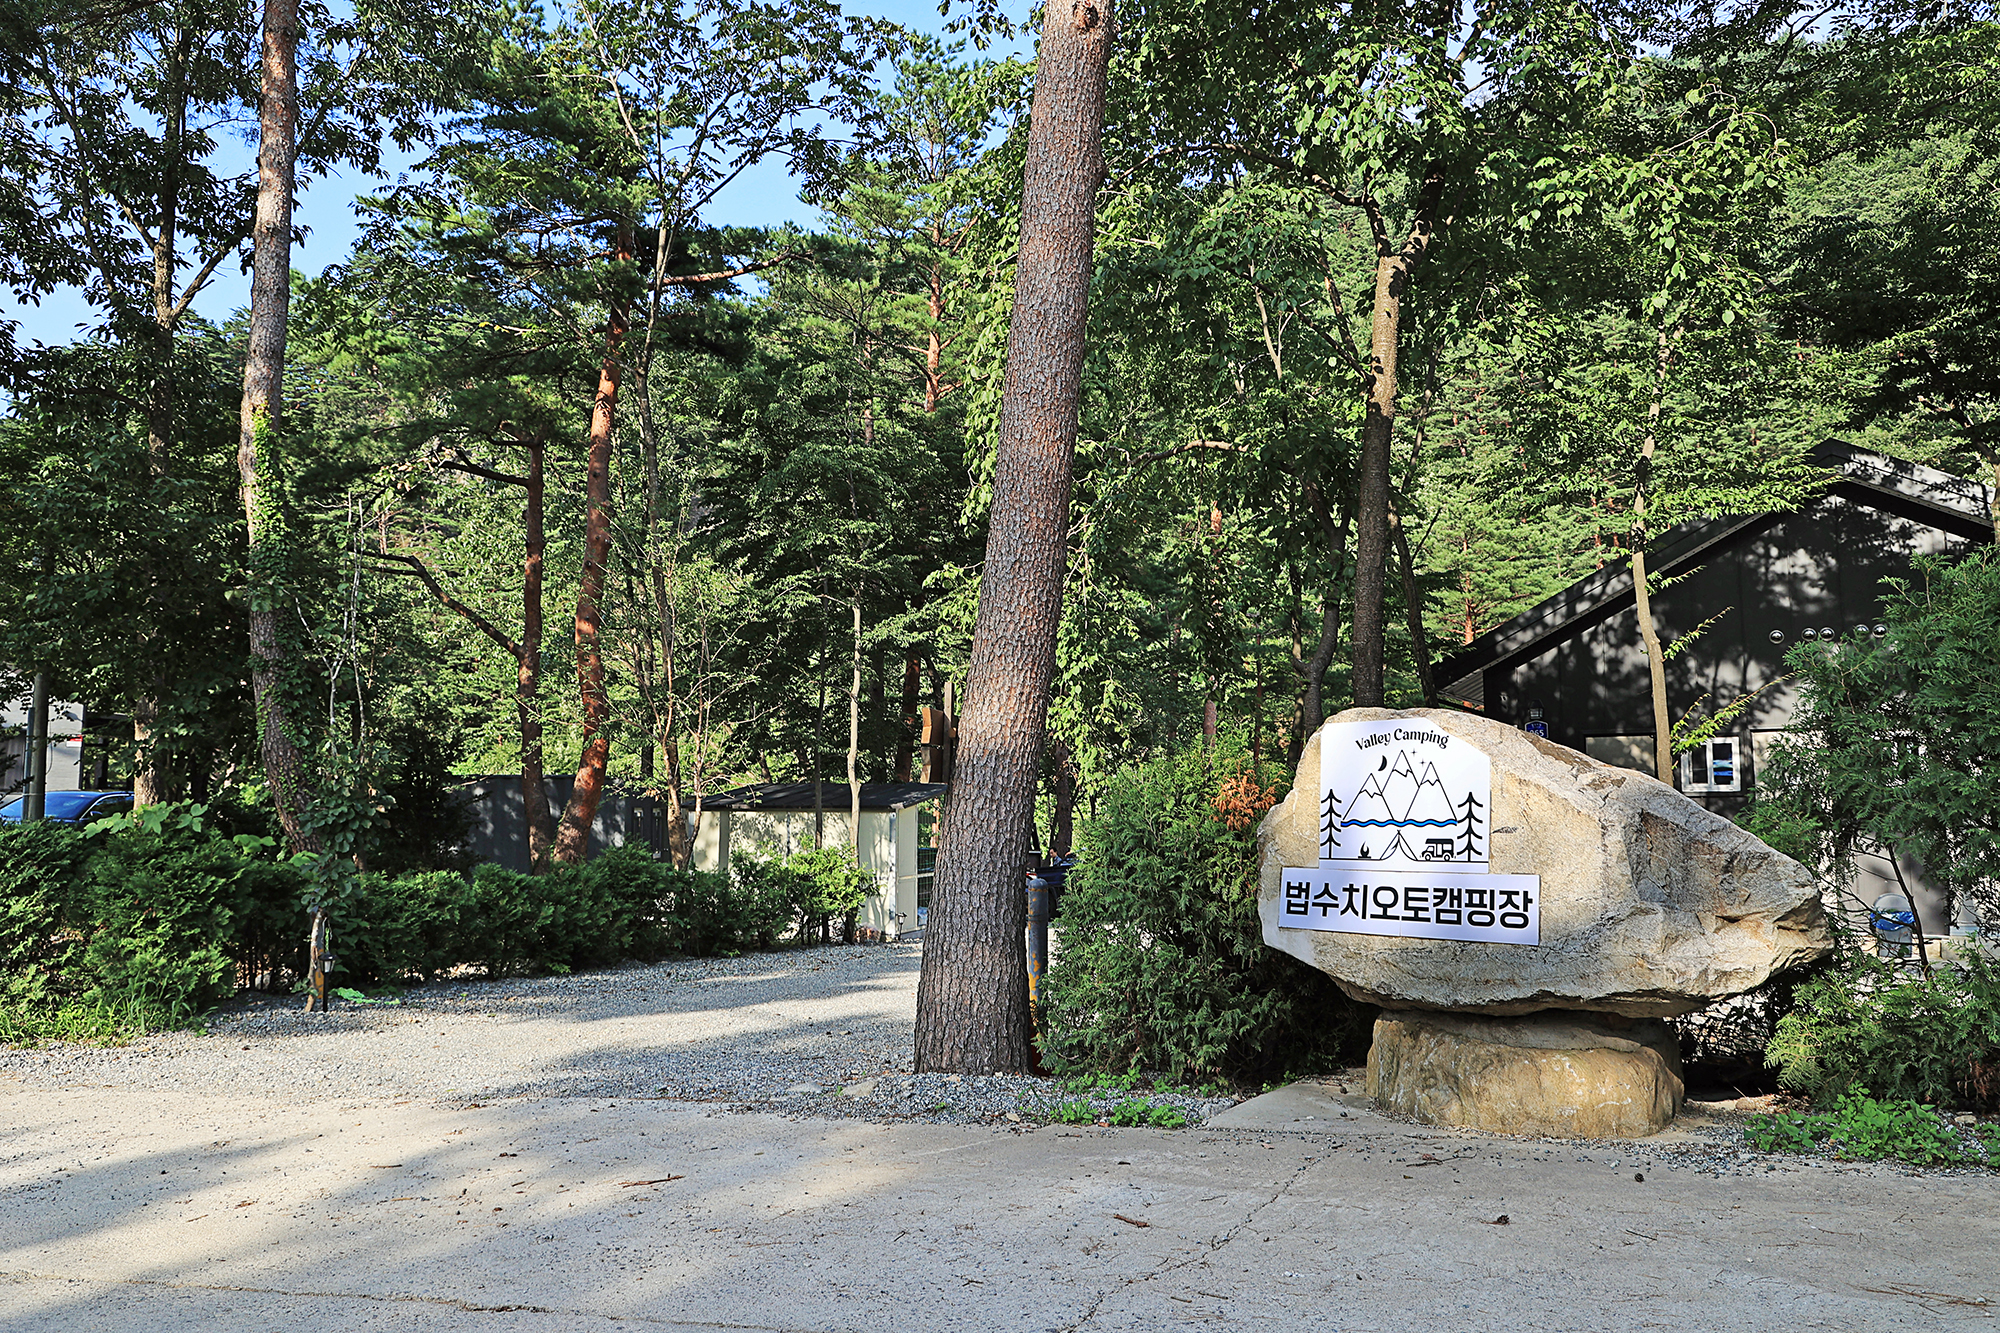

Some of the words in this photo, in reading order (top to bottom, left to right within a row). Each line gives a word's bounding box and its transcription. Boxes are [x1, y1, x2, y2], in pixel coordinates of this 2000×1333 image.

[1355, 732, 1391, 750] Valley
[1393, 728, 1450, 749] Camping
[1285, 881, 1533, 929] 법수치오토캠핑장
